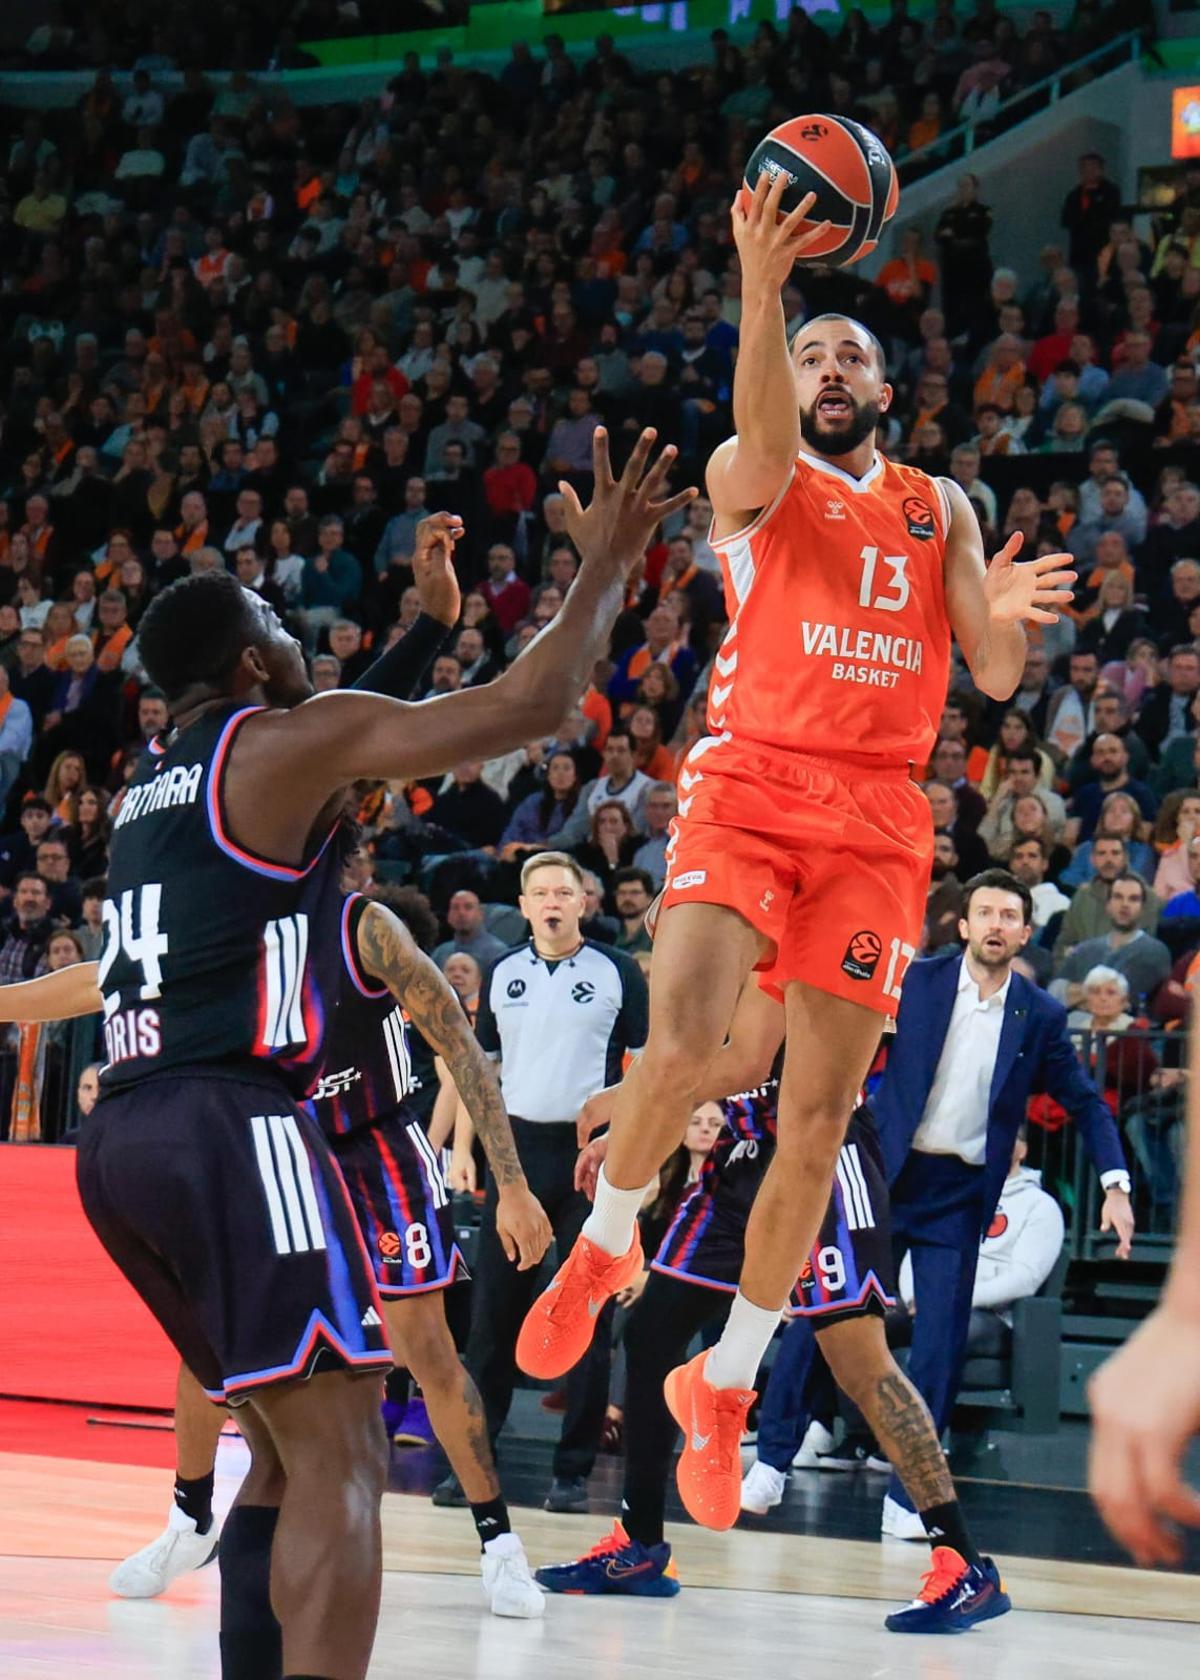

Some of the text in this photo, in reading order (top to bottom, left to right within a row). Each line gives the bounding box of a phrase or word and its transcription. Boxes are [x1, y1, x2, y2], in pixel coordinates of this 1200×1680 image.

[859, 546, 910, 612] 13
[801, 621, 923, 676] VALENCIA
[831, 662, 900, 689] BASKET
[104, 1007, 161, 1065] ARIS
[405, 1222, 432, 1269] 8
[817, 1245, 847, 1292] 9
